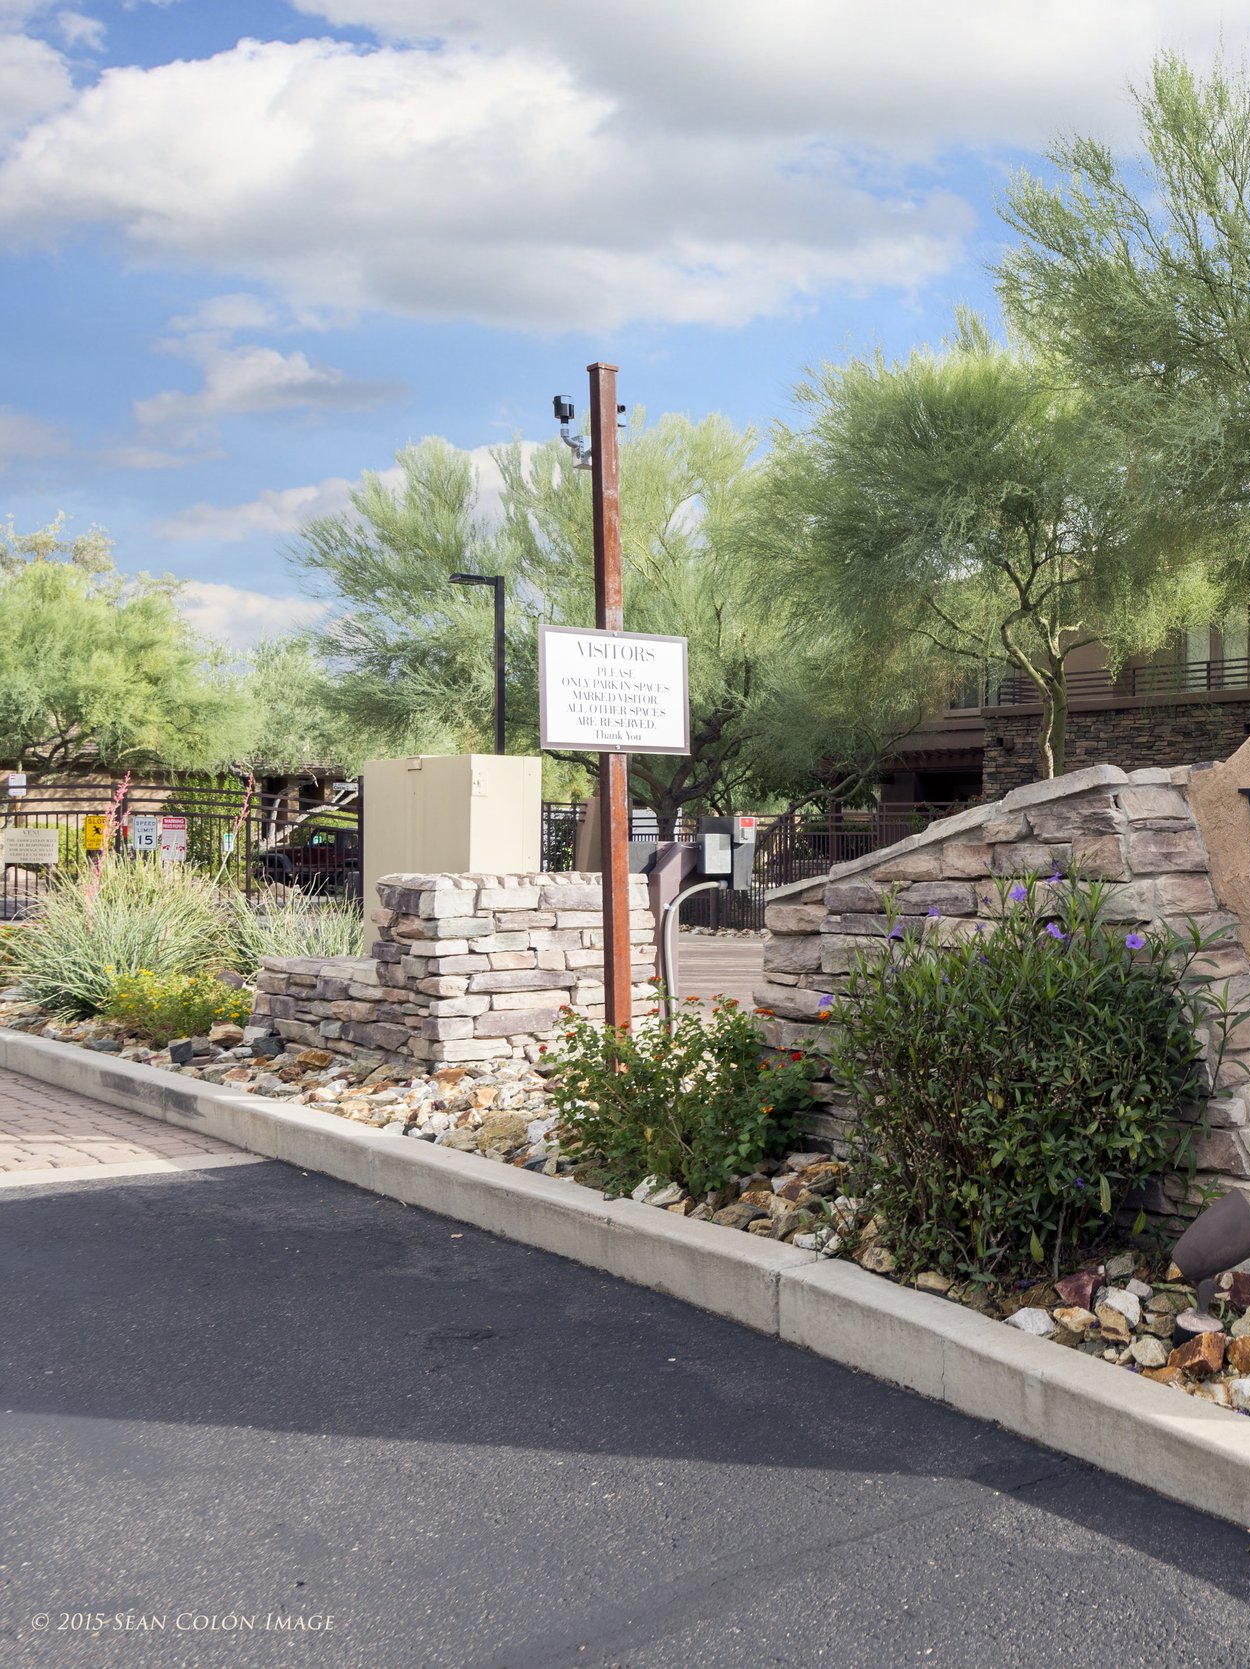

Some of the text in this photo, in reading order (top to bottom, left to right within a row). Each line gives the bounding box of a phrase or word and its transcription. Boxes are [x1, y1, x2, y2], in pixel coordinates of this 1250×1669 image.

[577, 641, 655, 662] VISITORS
[561, 677, 670, 693] ONLY PARK IN SPACES
[572, 691, 616, 702] MARKED
[566, 703, 666, 717] ALL OTHER SPACES
[576, 716, 656, 729] ARE RESERVED.
[594, 730, 642, 741] Thank You
[138, 835, 153, 845] 15
